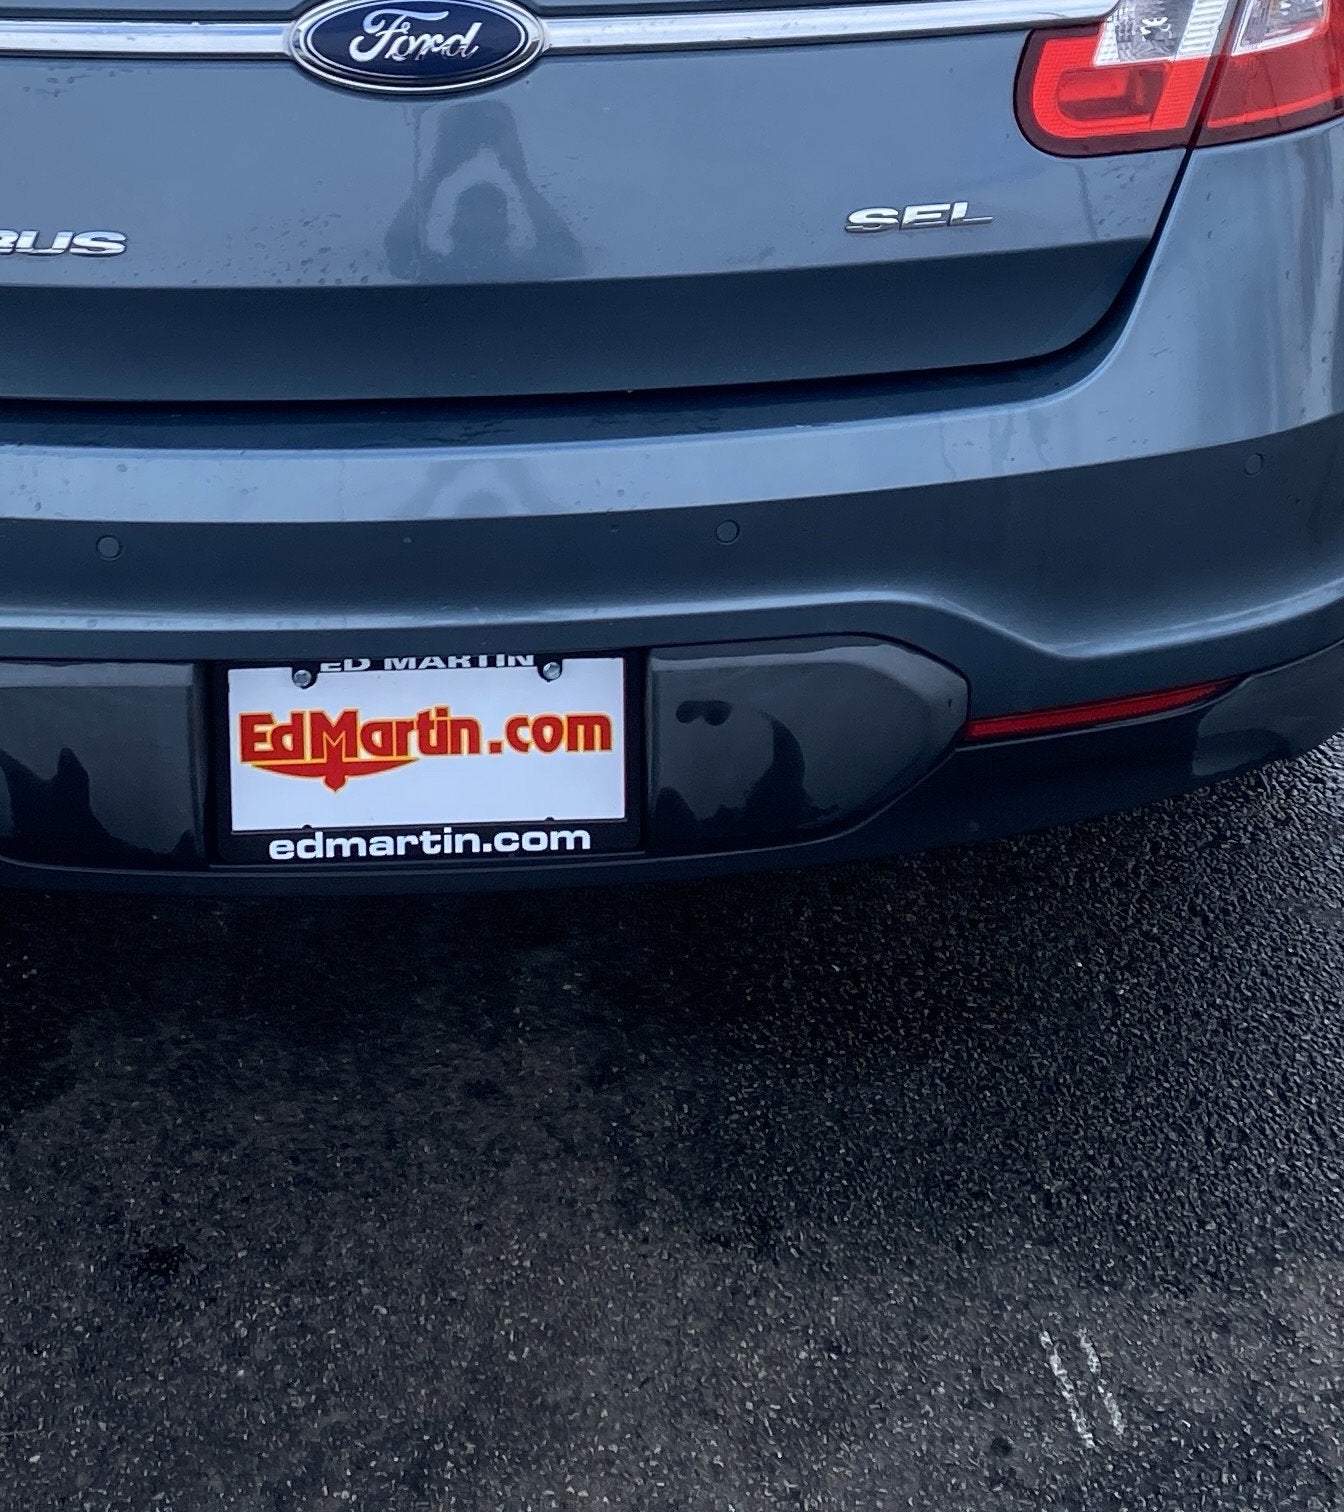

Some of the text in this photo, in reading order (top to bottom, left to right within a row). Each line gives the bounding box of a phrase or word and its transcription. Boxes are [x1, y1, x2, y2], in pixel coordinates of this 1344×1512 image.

[348, 7, 483, 62] Ford
[845, 201, 994, 234] SEL
[269, 826, 591, 861] edmartin.com
